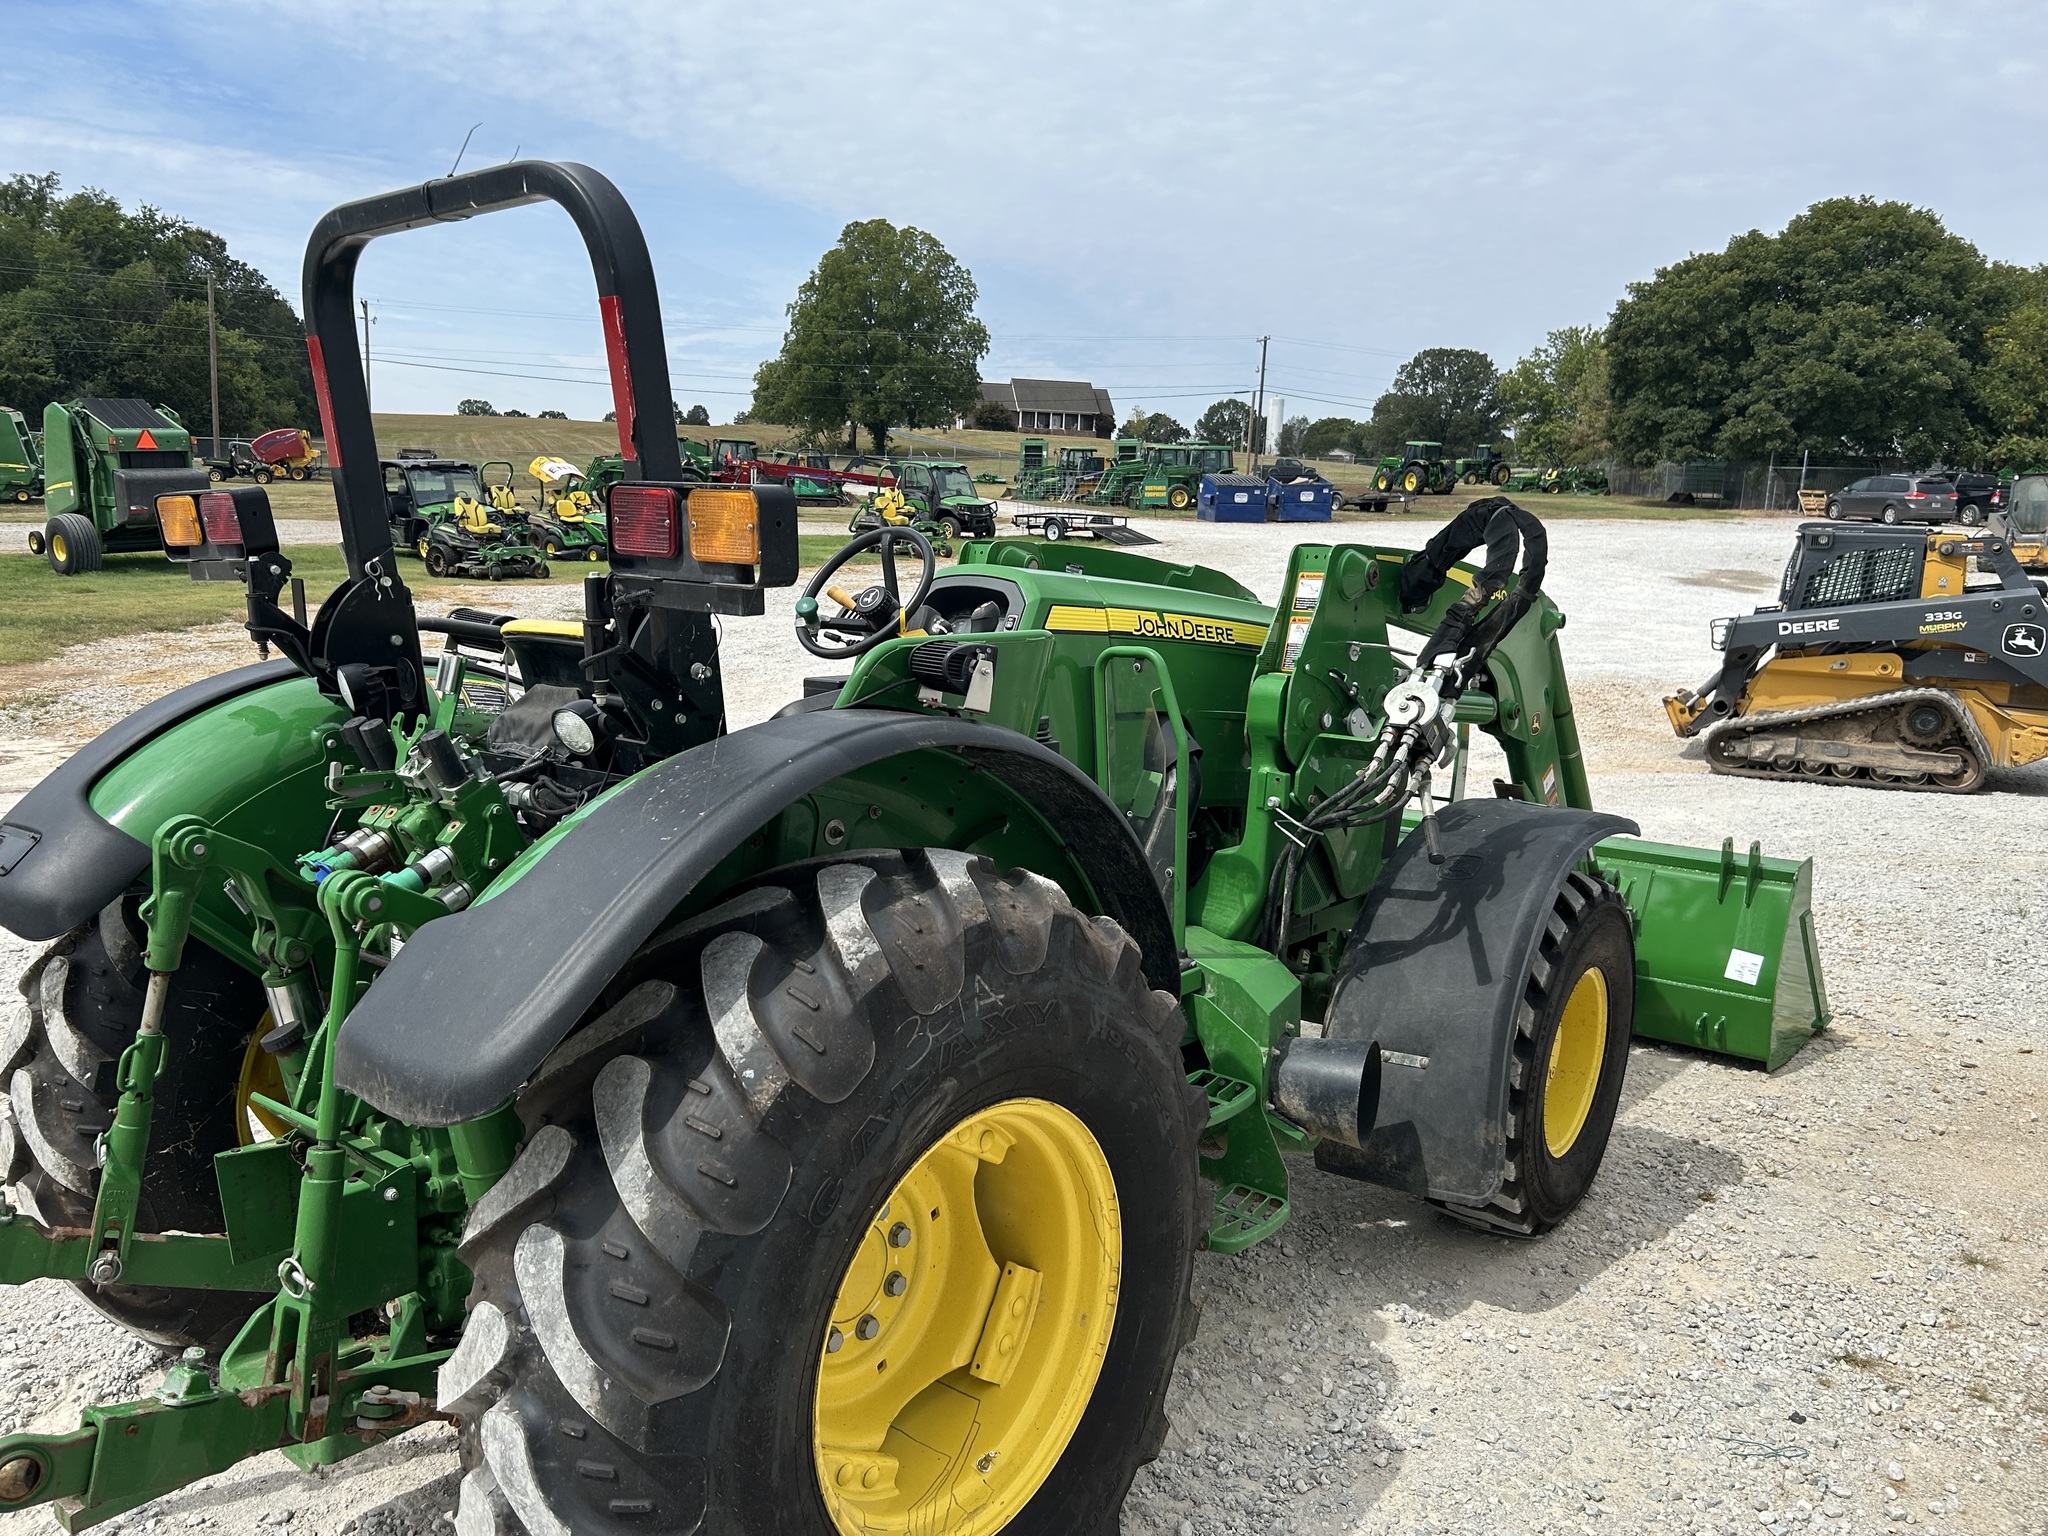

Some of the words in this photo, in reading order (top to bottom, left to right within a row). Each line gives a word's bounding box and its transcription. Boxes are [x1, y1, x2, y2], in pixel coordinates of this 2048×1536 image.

[1924, 611, 1962, 622] 333G
[1133, 614, 1180, 637] JOHN
[1181, 619, 1235, 643] DEERE
[1778, 619, 1840, 636] DEERE
[1919, 621, 1968, 632] MURPHY
[808, 1000, 1057, 1228] GALAXY
